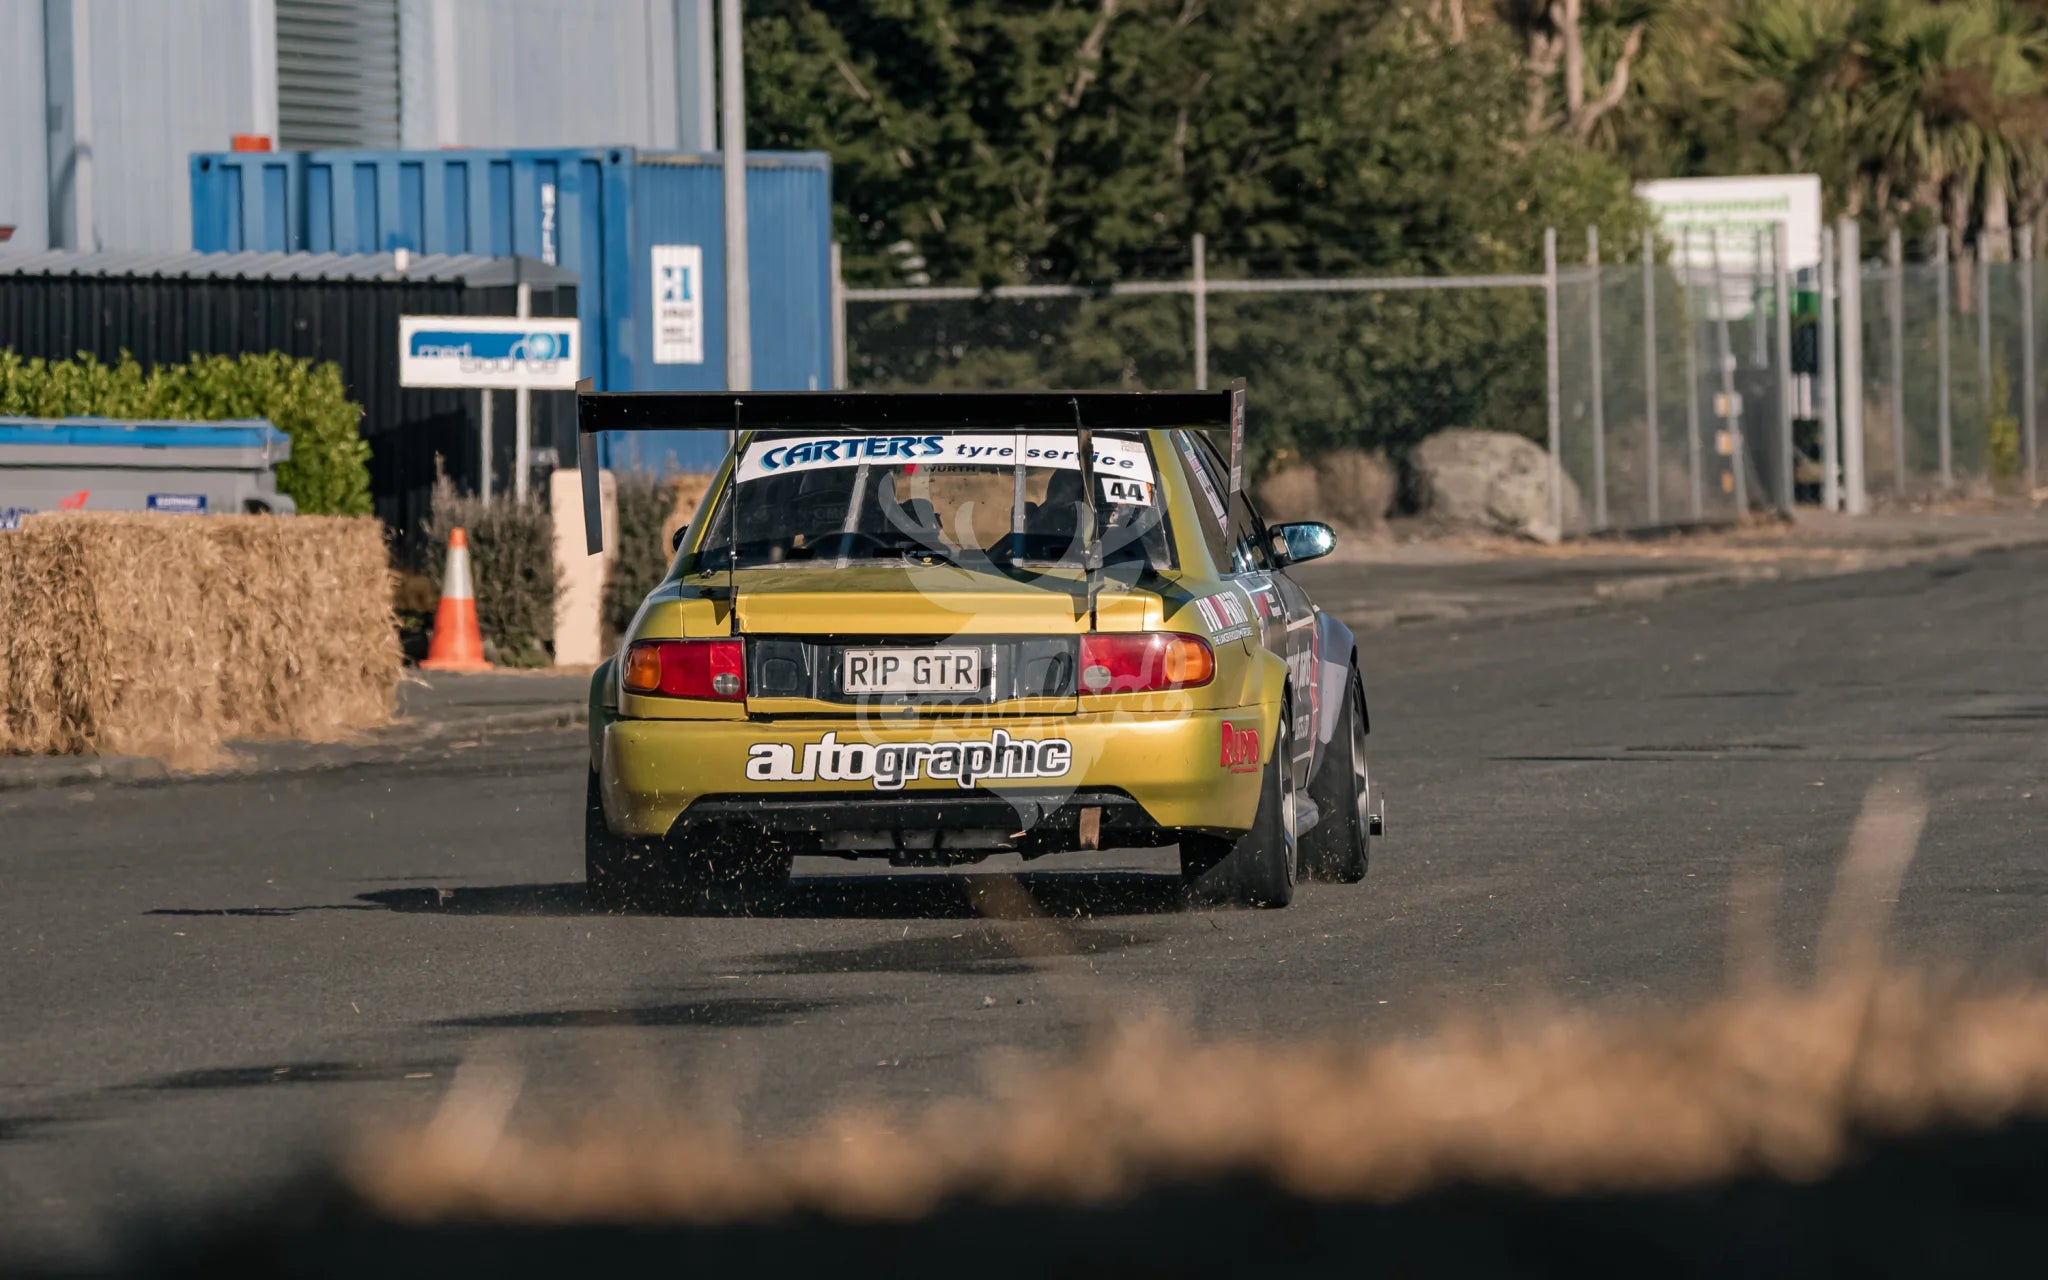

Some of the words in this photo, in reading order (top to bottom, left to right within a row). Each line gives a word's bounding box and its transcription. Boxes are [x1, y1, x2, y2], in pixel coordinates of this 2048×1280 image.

[760, 436, 944, 471] CARTER'S
[957, 444, 1014, 459] tyre
[1026, 447, 1135, 469] serice
[1110, 482, 1144, 502] 44
[850, 656, 900, 686] RIP
[913, 656, 974, 686] GTR
[745, 728, 1073, 791] autographic
